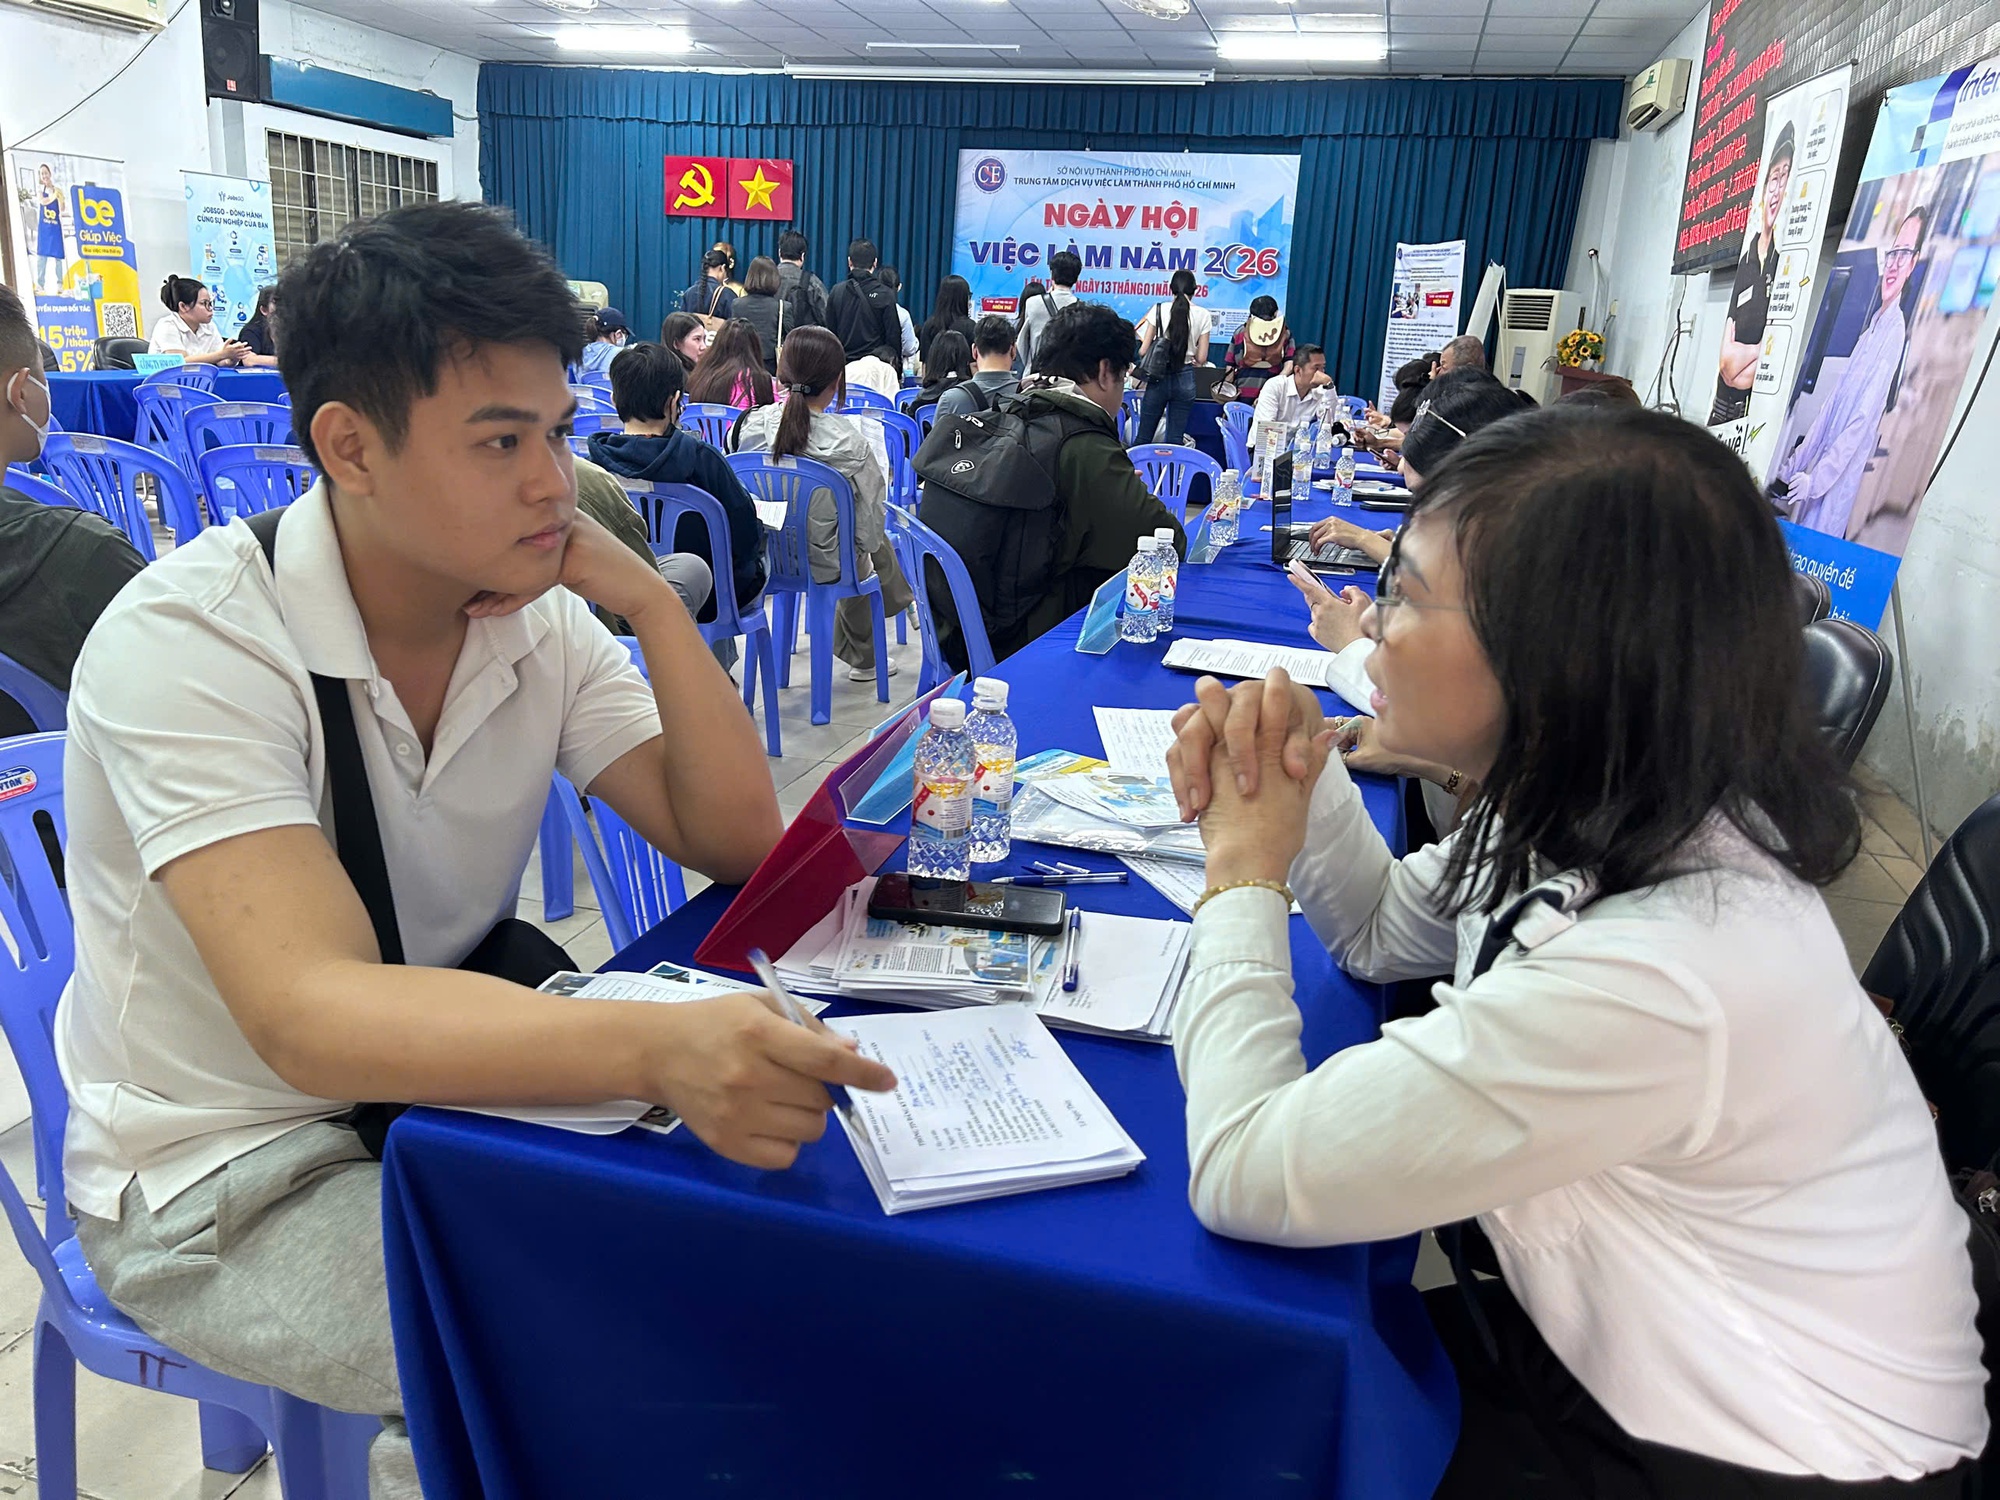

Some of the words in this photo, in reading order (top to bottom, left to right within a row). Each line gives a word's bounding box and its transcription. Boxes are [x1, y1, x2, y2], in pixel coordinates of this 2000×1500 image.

[1057, 166, 1067, 175] SỞ
[1069, 167, 1082, 176] NỘI
[1083, 168, 1094, 177] VỤ
[1095, 167, 1122, 176] THÀNH
[1124, 167, 1141, 177] PHỐ
[1142, 167, 1154, 177] HỒ
[1156, 168, 1169, 177] CHÍ
[1042, 177, 1059, 185] TÂM
[1061, 178, 1080, 188] DỊCH
[1082, 179, 1093, 188] VỤ
[1095, 178, 1112, 189] VIỆC
[1114, 178, 1131, 188] LÀM
[1133, 179, 1161, 188] THÀNH
[1163, 178, 1181, 189] PHỐ
[1183, 179, 1195, 189] HỒ
[1197, 179, 1212, 189] CHÍ
[1213, 181, 1235, 190] MINH
[44, 206, 56, 220] be
[78, 188, 115, 227] be
[203, 206, 225, 215] JOBSGO
[246, 209, 262, 218] HÀNH
[223, 218, 243, 226] NGHIỆP
[1043, 198, 1136, 229] NGÀY
[1141, 200, 1199, 238] HỘI
[79, 230, 102, 244] Giúp
[102, 230, 122, 245] Việc
[968, 235, 1040, 272] VIỆC
[1120, 241, 1197, 271] NĂM
[1203, 243, 1280, 281] 2026
[64, 325, 88, 338] triệu
[1838, 566, 1857, 590] để
